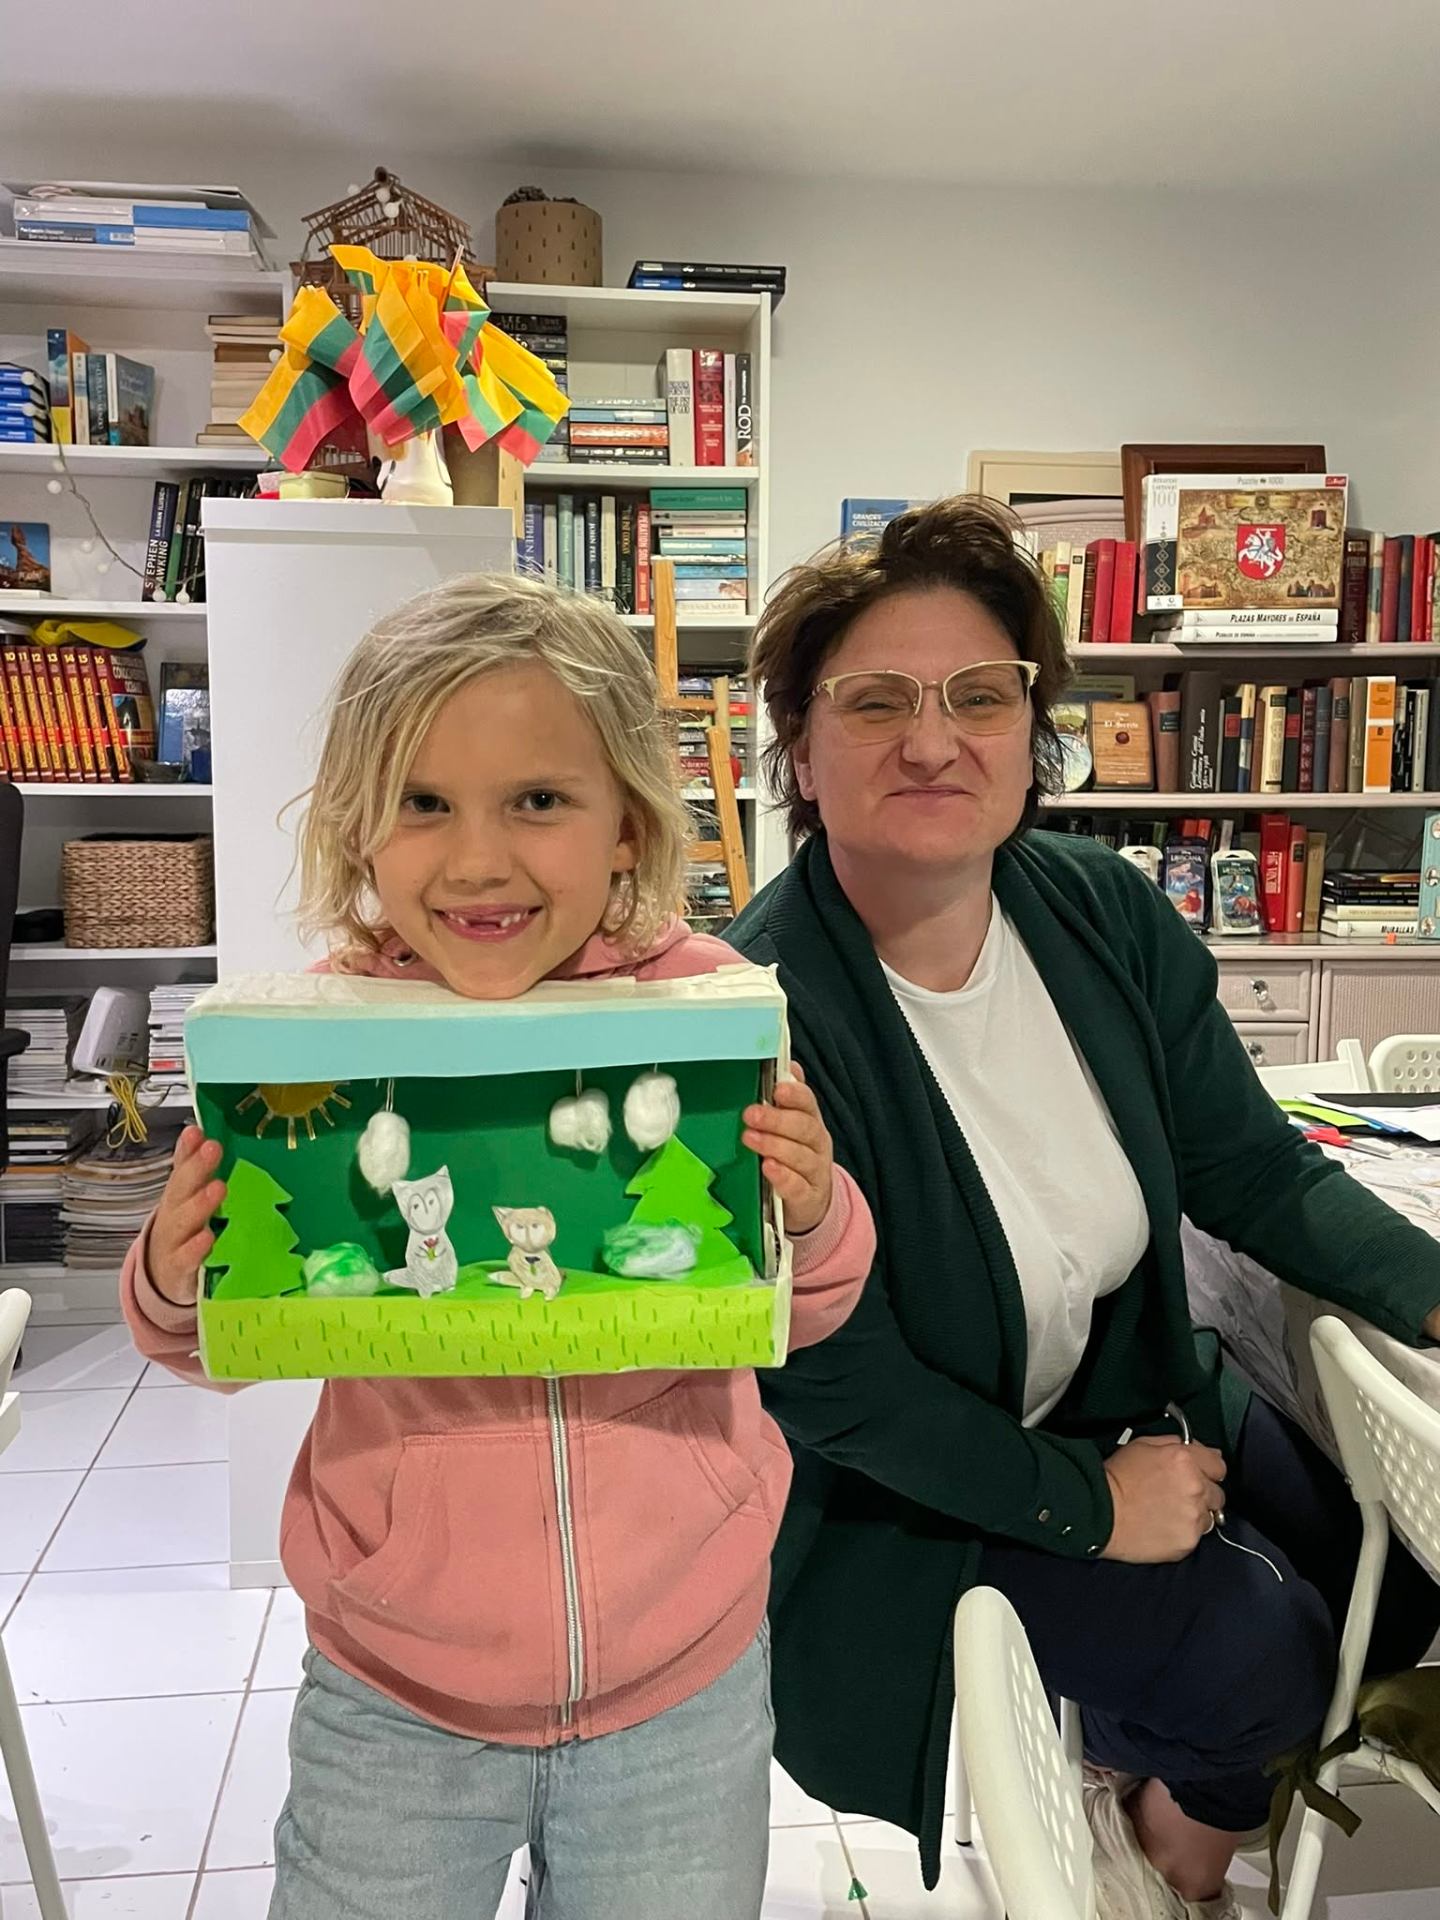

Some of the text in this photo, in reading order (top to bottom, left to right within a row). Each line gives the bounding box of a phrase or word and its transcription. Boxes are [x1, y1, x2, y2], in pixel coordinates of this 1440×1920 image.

[738, 405, 752, 439] ROD
[638, 549, 648, 566] SOLO
[145, 539, 159, 588] SEPHEN
[1230, 614, 1255, 623] PLAZAS
[1256, 614, 1287, 623] MAYORES
[1295, 611, 1321, 623] ESPAÑA
[4, 652, 16, 661] 10
[18, 652, 28, 661] 11
[31, 653, 41, 662] 12
[47, 653, 58, 662] 13
[64, 654, 75, 663] 14
[78, 654, 88, 663] 15
[94, 655, 105, 665] 16
[1381, 925, 1415, 934] MURALLAS
